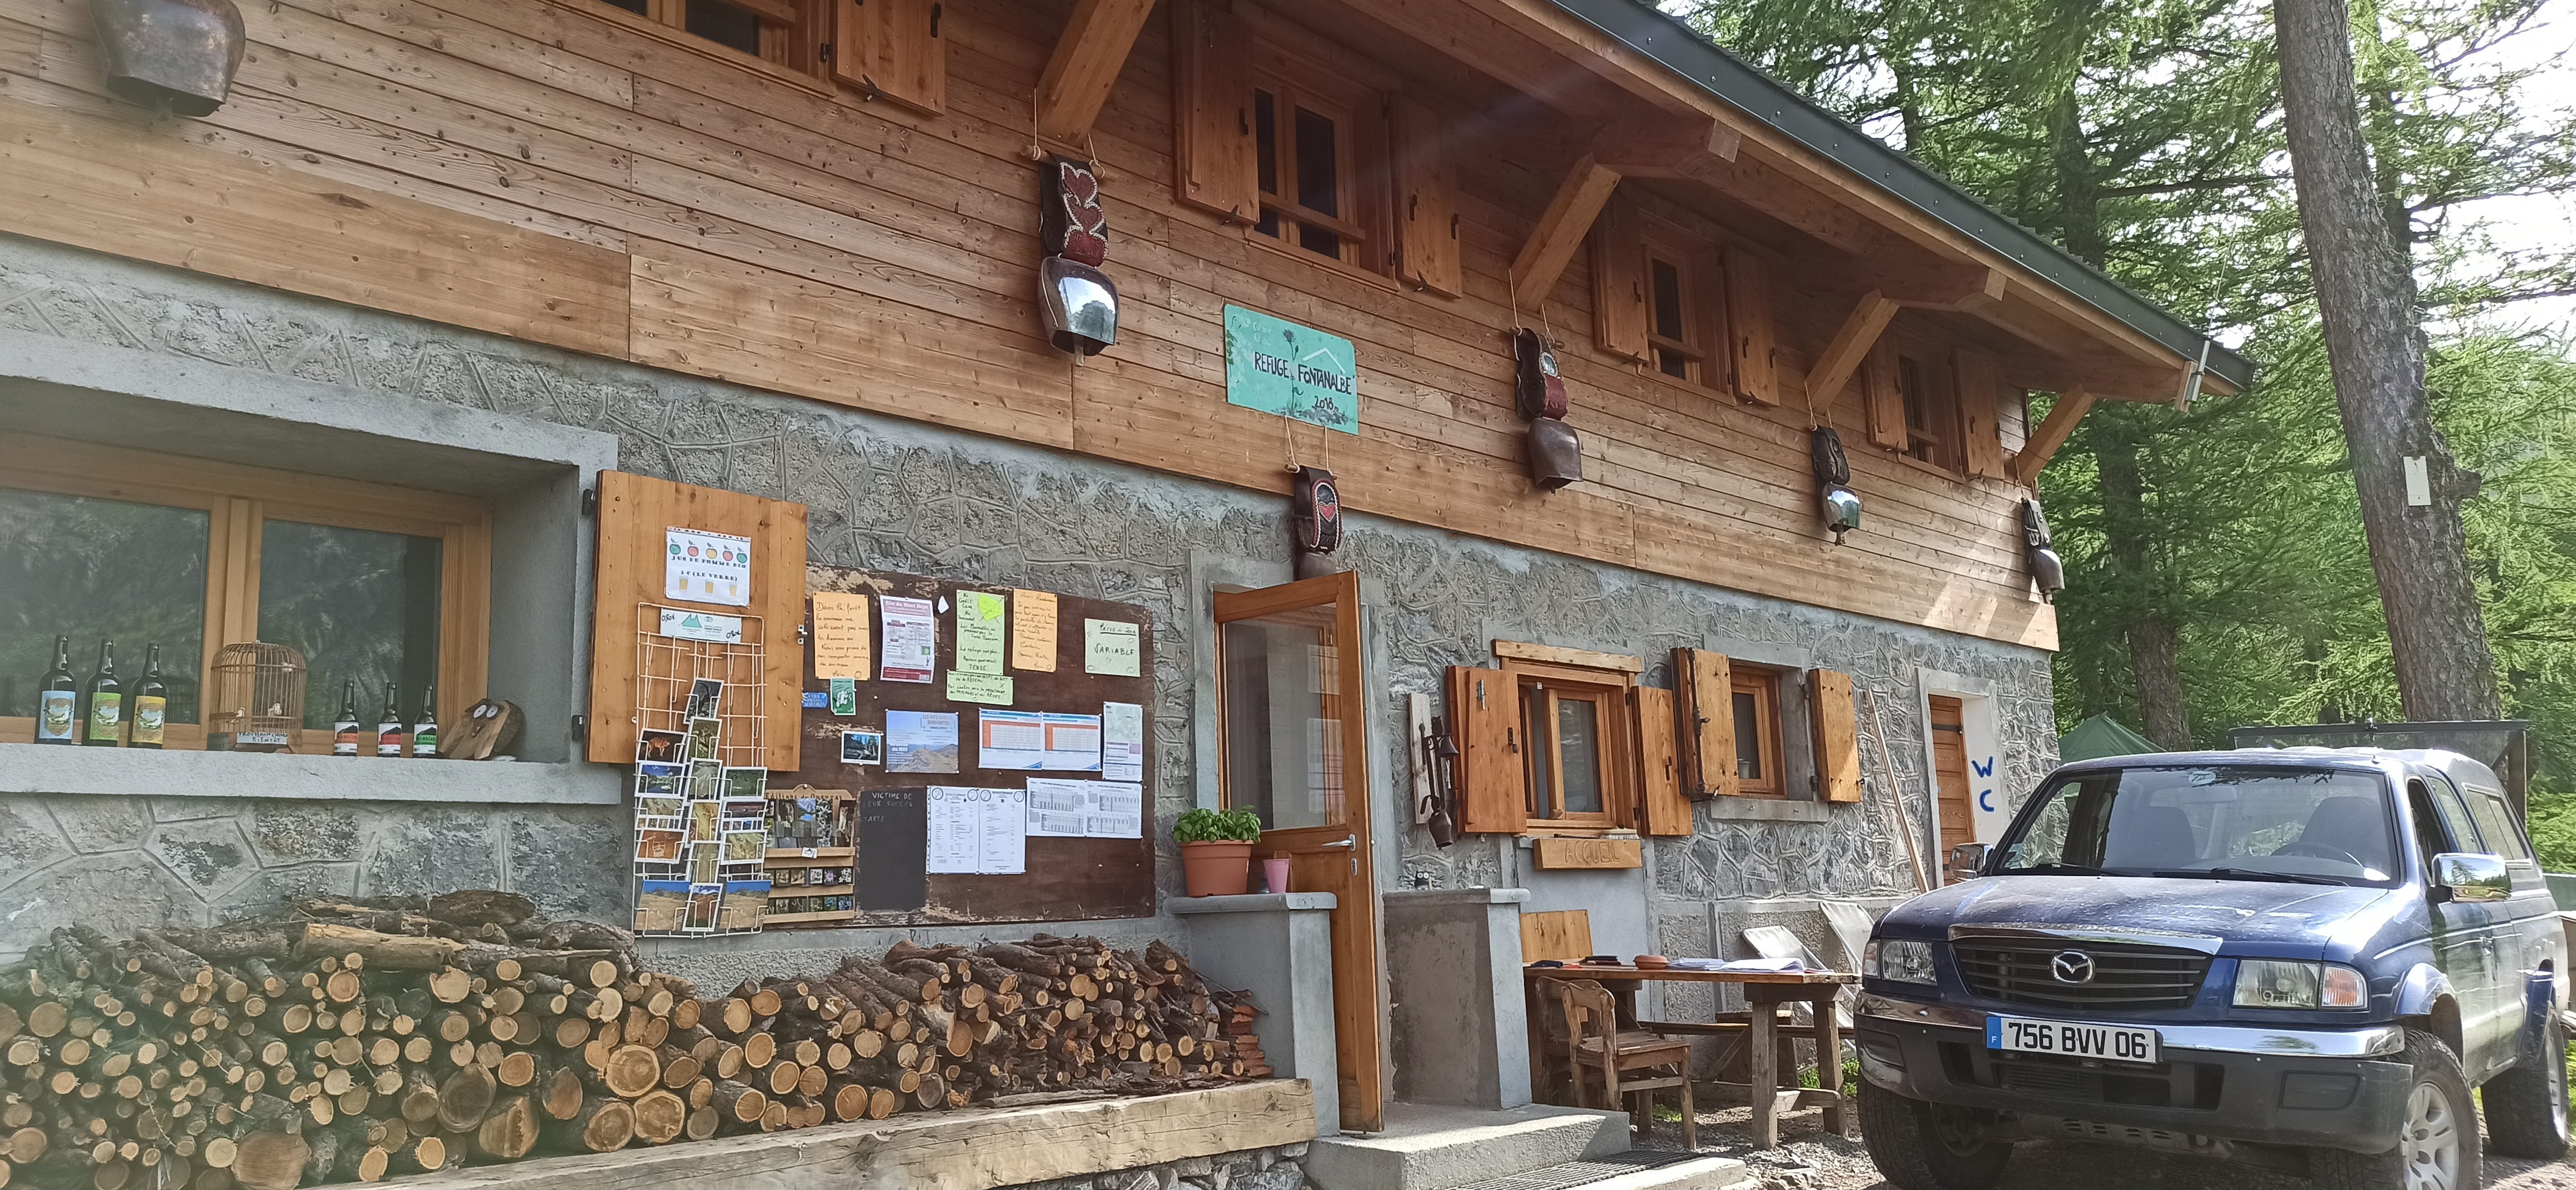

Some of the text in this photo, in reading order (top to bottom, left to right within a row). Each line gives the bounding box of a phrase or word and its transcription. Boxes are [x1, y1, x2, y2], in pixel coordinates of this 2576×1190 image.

[1255, 351, 1290, 379] REFUGE
[1297, 363, 1352, 396] FONTANALBE
[816, 602, 833, 612] Dans
[1094, 643, 1134, 656] VARIABLE
[1565, 840, 1621, 864] ACCUEIL
[2008, 1022, 2146, 1059] 756 BVV 06
